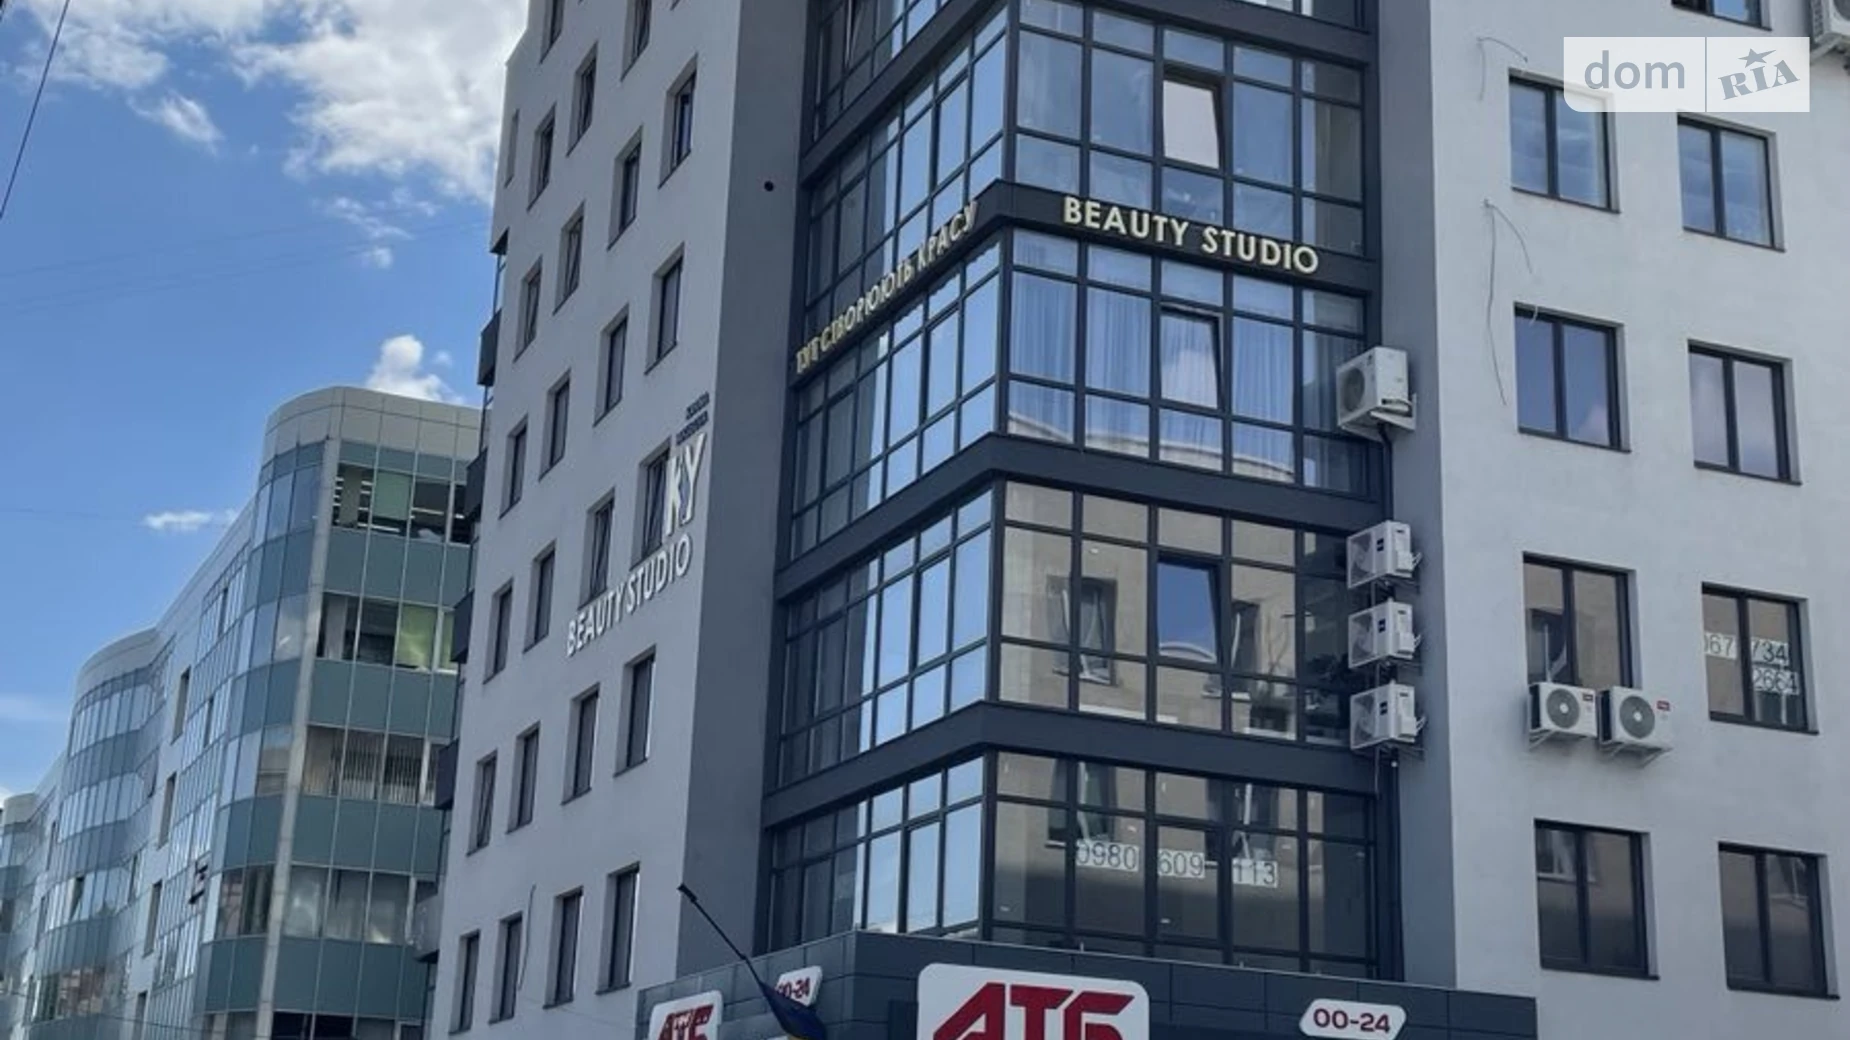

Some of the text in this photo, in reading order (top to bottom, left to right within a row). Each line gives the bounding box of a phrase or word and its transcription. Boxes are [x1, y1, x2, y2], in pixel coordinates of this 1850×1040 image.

[1064, 196, 1319, 274] BEAUTY STUDIO
[820, 258, 914, 352] СТВОРЮЮТЬ
[917, 200, 979, 271] КРАСУ
[566, 533, 692, 658] BEAUTY STUDIO
[1076, 840, 1138, 870] 0980
[1158, 851, 1204, 877] 609
[1313, 1008, 1390, 1033] 00-24
